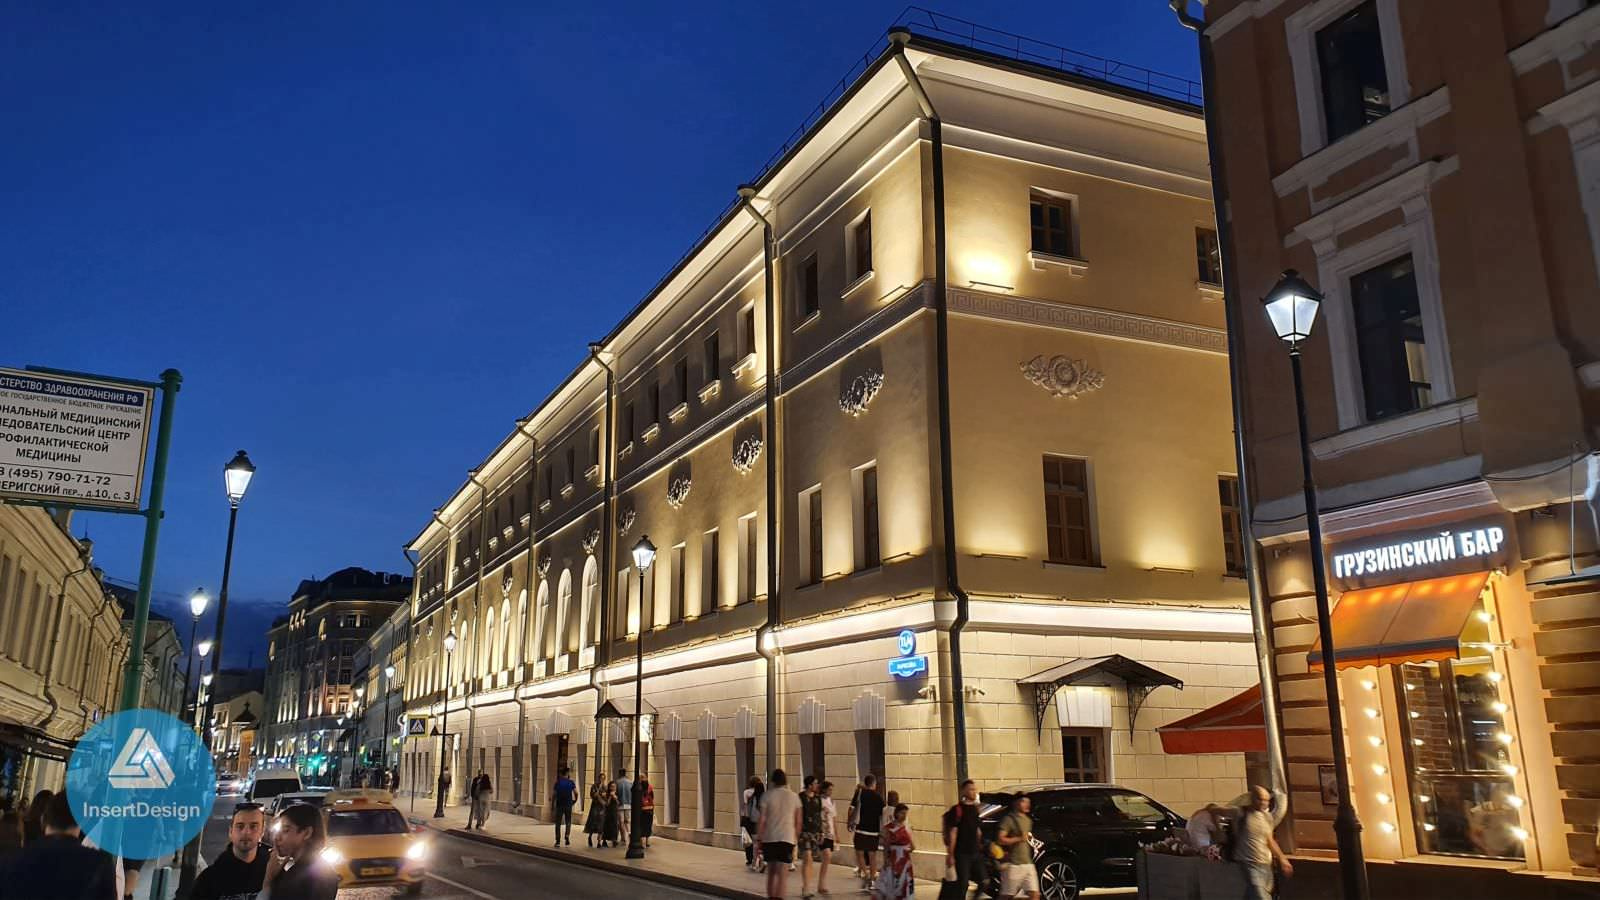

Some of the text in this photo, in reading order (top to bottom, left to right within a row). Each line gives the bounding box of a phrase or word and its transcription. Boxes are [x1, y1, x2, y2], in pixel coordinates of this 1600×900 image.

[11, 392, 67, 404] ГОСУДАРСТВЕННОЕ
[68, 400, 104, 409] БЮДЖЕТНОЕ
[105, 405, 142, 414] УЧРЕЖДЕНИЕ
[44, 383, 125, 401] ЗДРАВООХРАНЕНИЯ
[126, 394, 139, 403] РФ
[0, 404, 141, 429] НАЛЬНЫЙ МЕДИЦИНСКИЙ
[97, 429, 130, 440] ЦЕНТР
[16, 448, 81, 463] МЕДИЦИНЫ
[9, 468, 43, 481] (495)
[47, 471, 111, 485] 790-71-72
[0, 480, 61, 494] ЕРИГСКИЙ
[123, 491, 131, 500] 3
[1334, 527, 1504, 578] ГРУЗИНСКИЙ БАР
